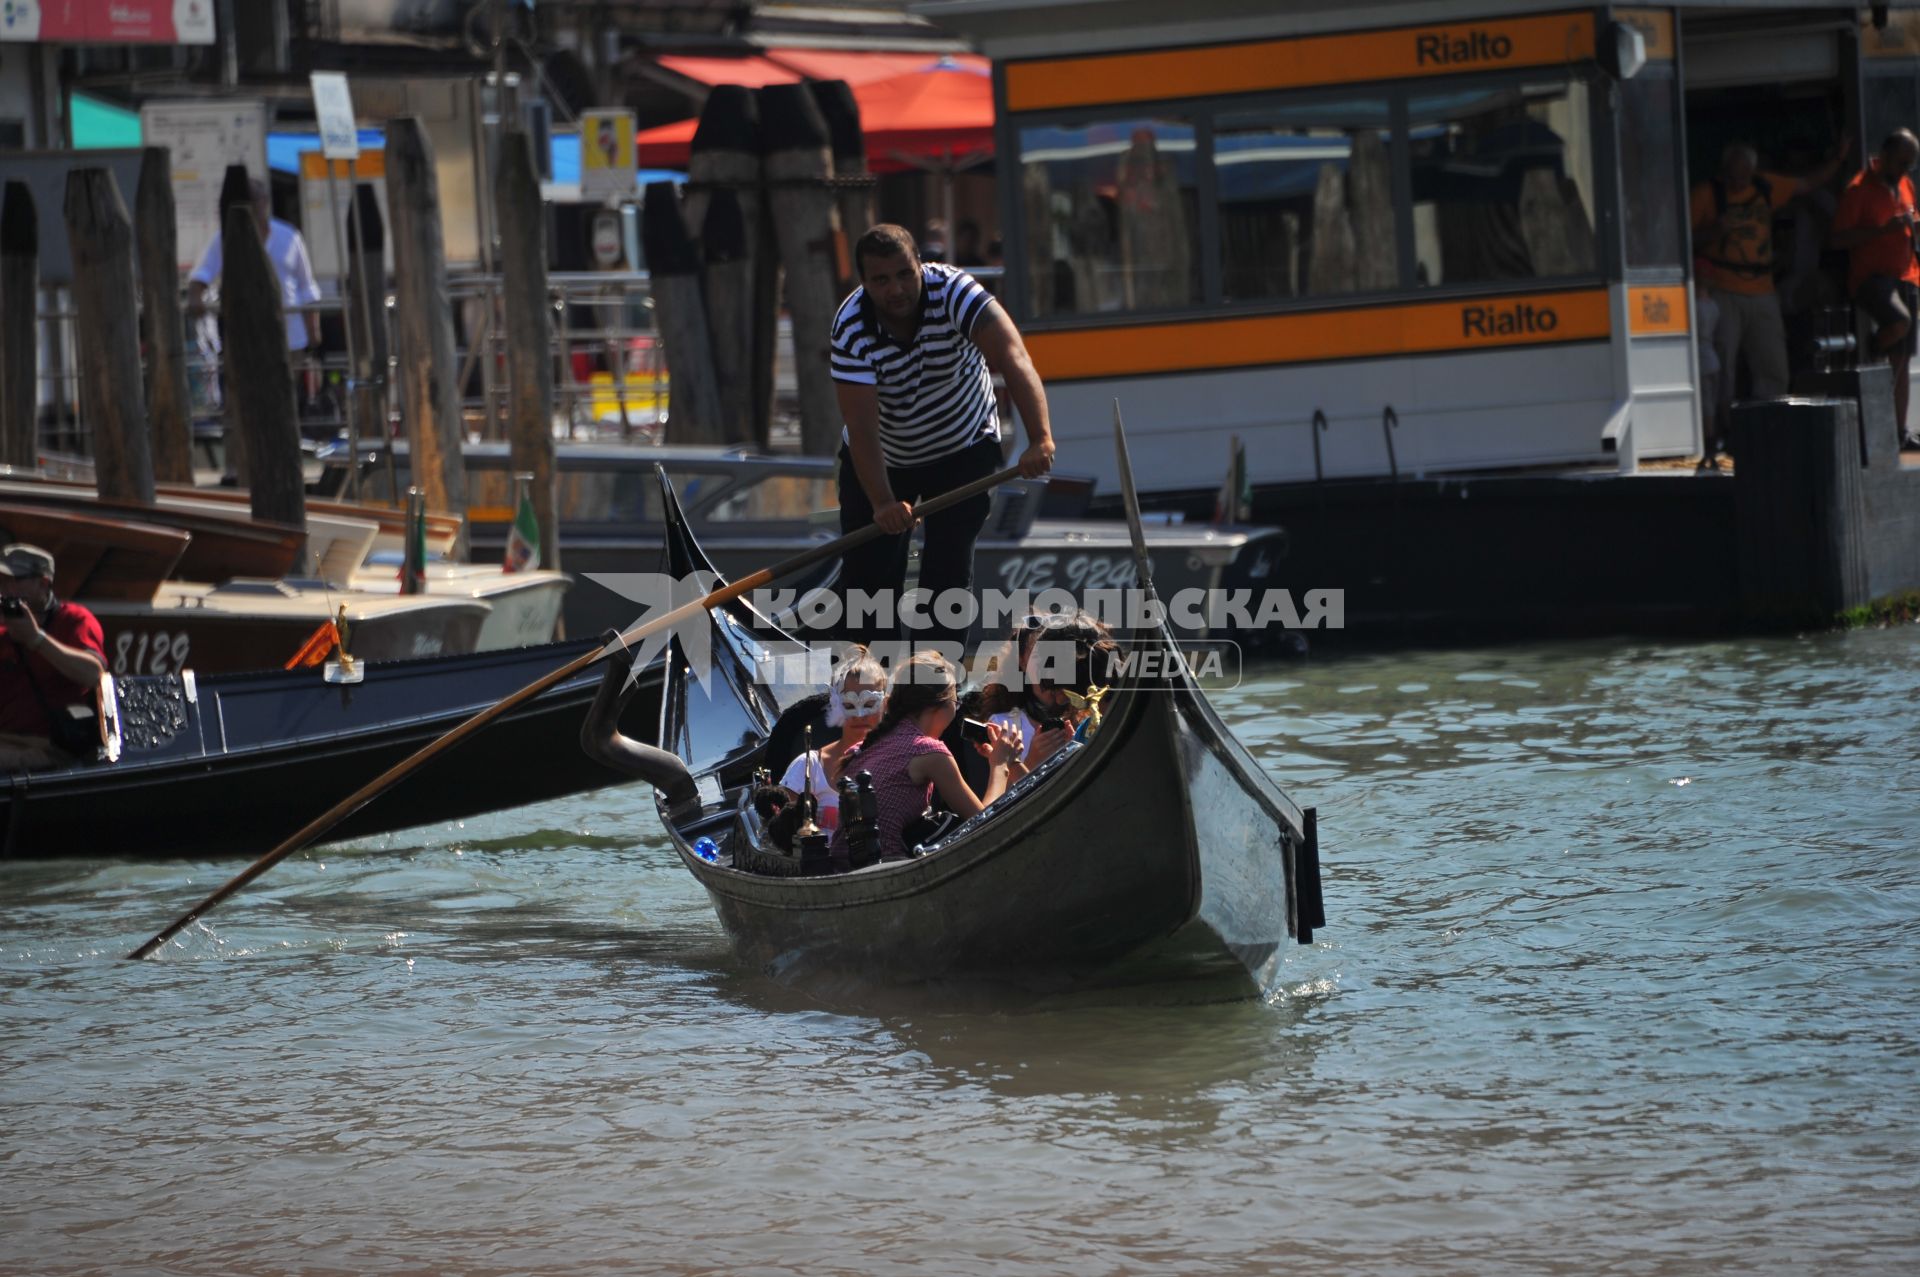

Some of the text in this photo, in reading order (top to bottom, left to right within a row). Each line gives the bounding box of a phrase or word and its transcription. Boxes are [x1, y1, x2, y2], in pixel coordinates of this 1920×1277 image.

[1416, 31, 1513, 66] Rialto
[1462, 304, 1558, 337] Rialto
[999, 554, 1057, 591] VE
[114, 631, 190, 676] 8129
